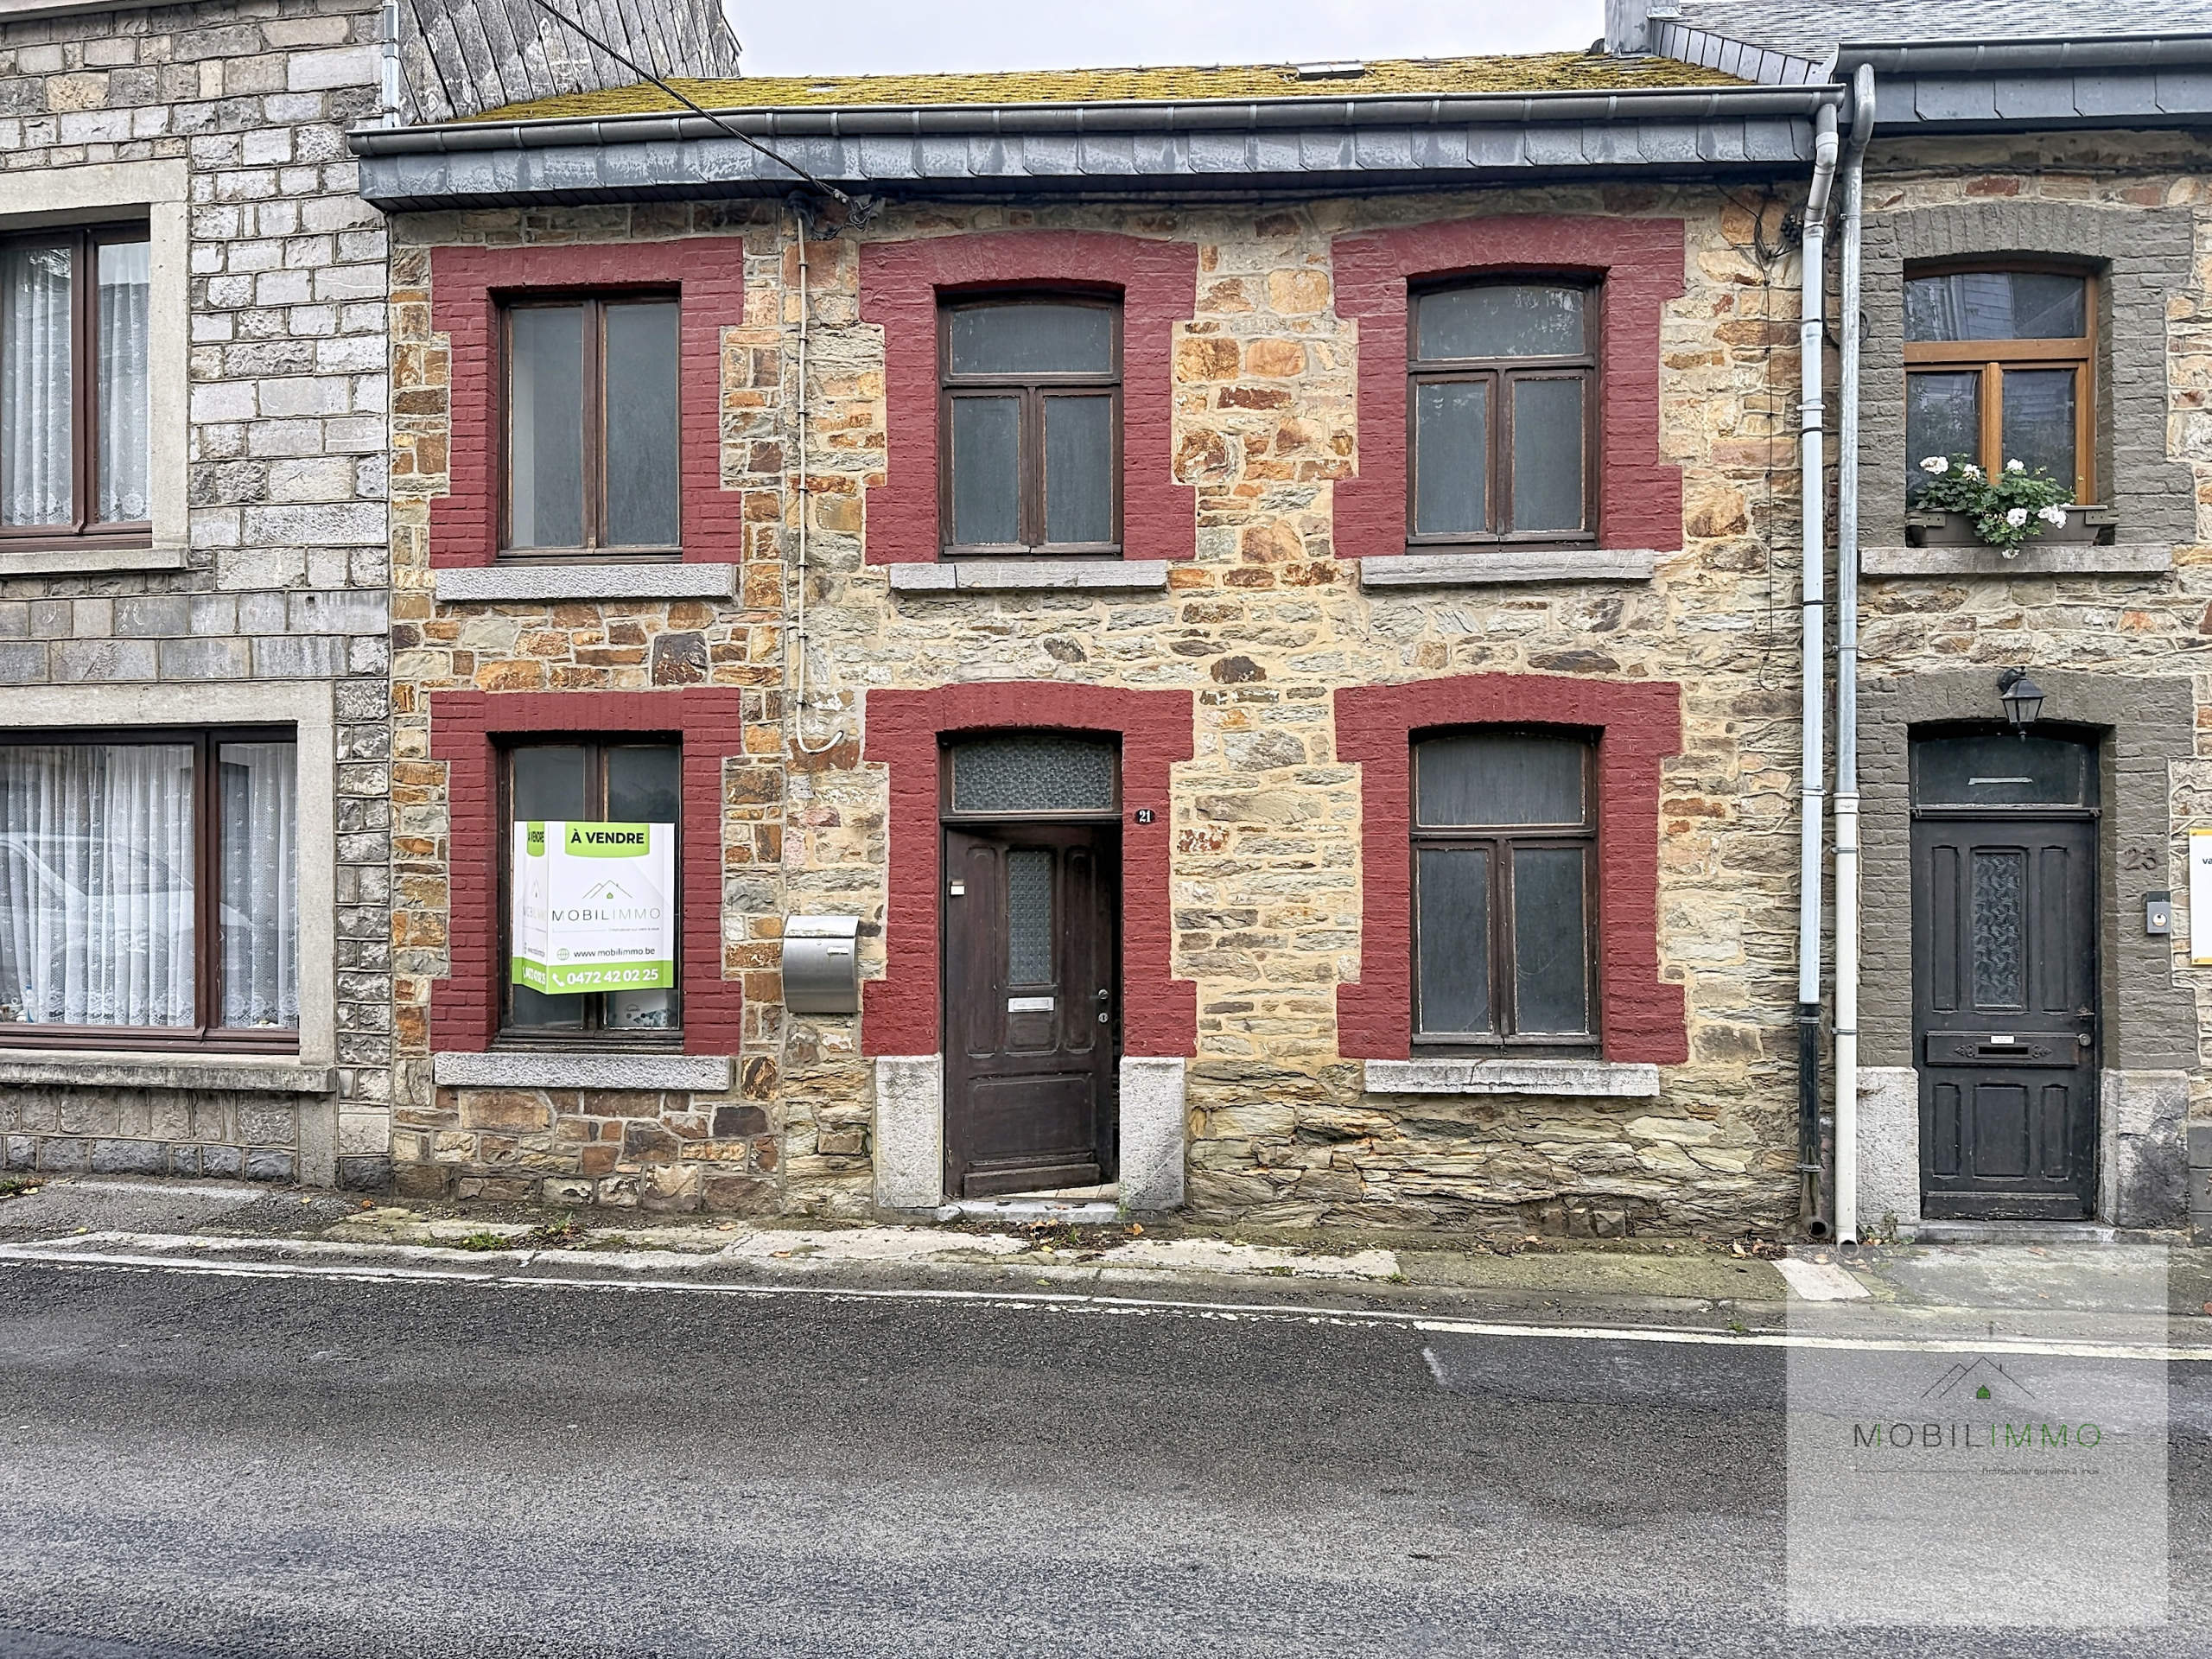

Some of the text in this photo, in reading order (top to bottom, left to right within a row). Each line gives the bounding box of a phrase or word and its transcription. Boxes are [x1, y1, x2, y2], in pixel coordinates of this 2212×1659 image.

[1139, 810, 1151, 823] 21
[570, 828, 645, 844] À VENDRE
[551, 907, 661, 922] MOBILIMMO
[573, 947, 656, 958] www.mobilimmo.be
[567, 968, 659, 985] 0472 42 02 25
